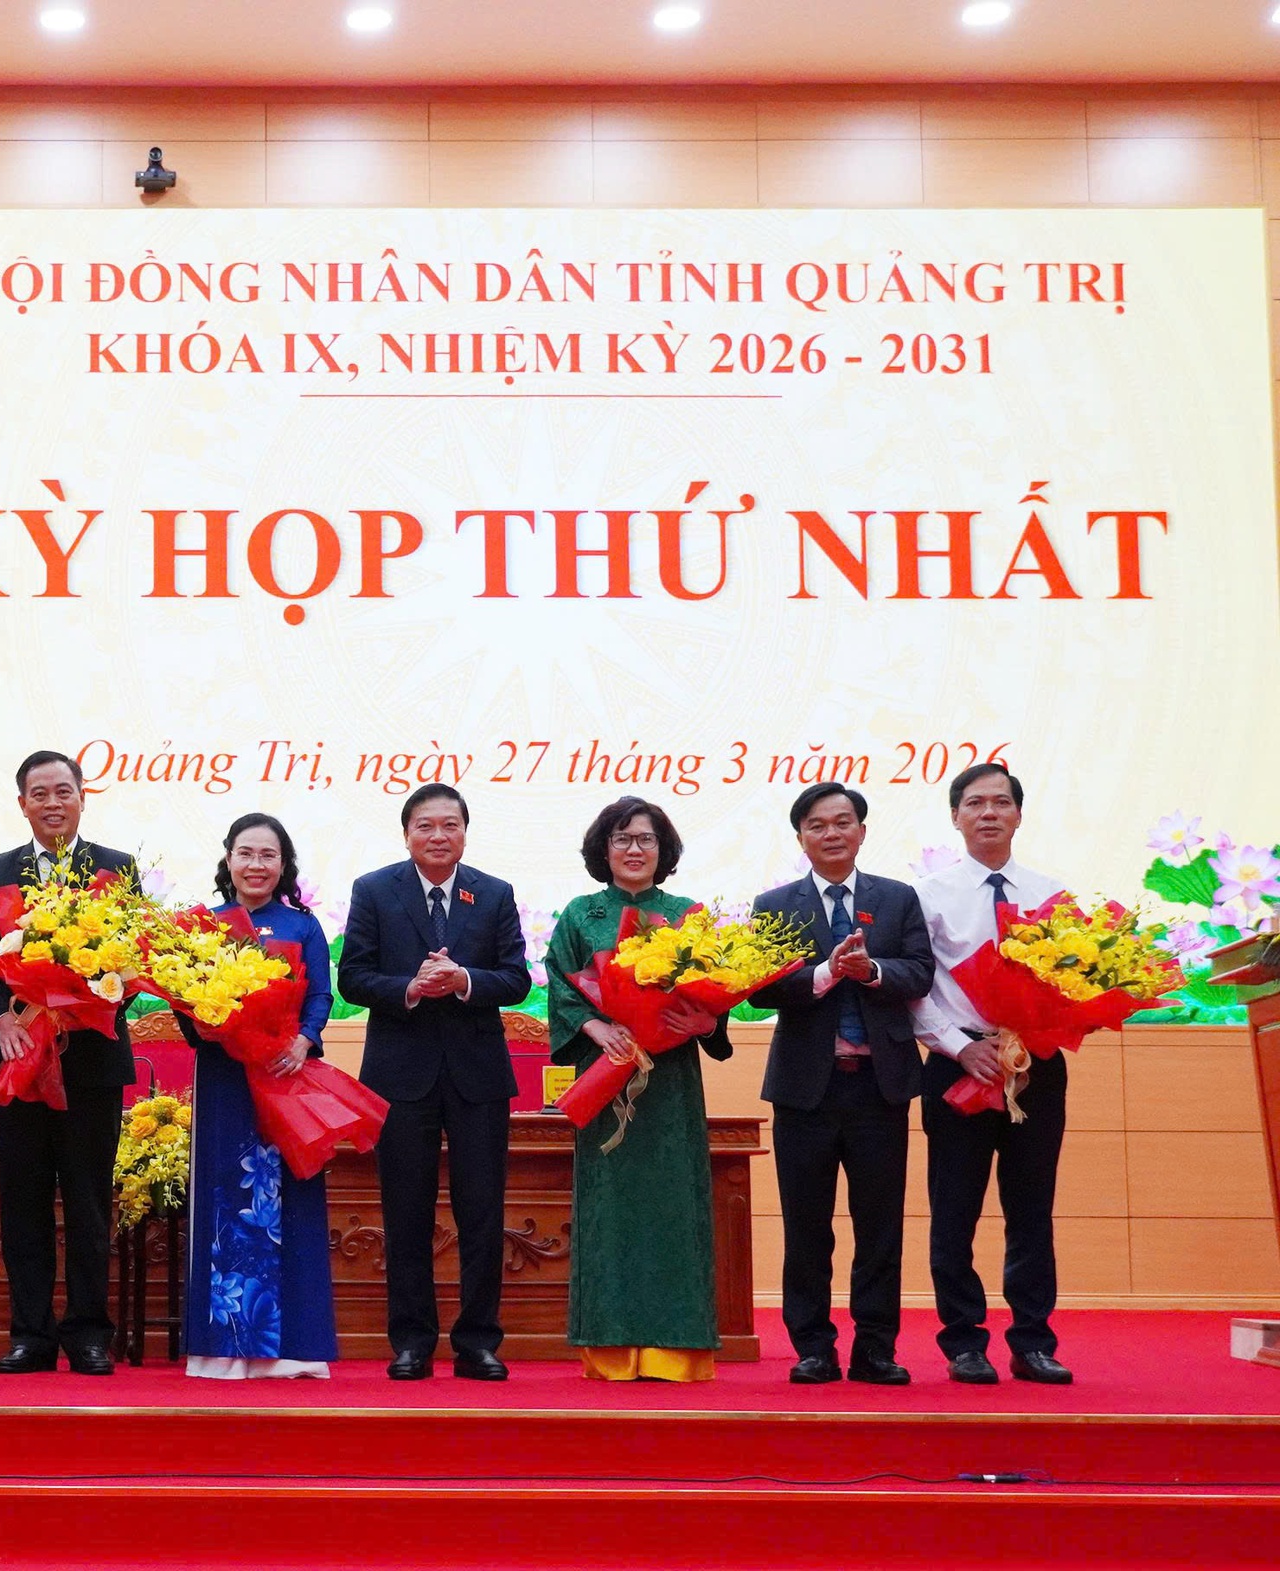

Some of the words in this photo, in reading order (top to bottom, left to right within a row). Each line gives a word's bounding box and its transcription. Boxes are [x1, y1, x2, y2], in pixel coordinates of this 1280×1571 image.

[85, 250, 261, 303] ĐỒNG
[281, 248, 451, 303] NHÂN
[474, 248, 597, 303] DÂN
[616, 250, 765, 303] TỈNH
[785, 250, 1006, 313] QUẢNG
[1024, 262, 1127, 315] TRỊ
[87, 321, 264, 374] KHÓA
[283, 333, 360, 383] IX,
[378, 326, 582, 386] NHIỆM
[606, 321, 689, 374] KỲ
[708, 333, 827, 375] 2026
[844, 356, 863, 364] -
[881, 333, 993, 375] 2031
[142, 508, 424, 626] HỌP
[455, 481, 756, 601] THỨ
[786, 481, 1169, 600] NHẤT
[75, 739, 238, 794] Quảng
[258, 740, 333, 793] Trị,
[355, 740, 473, 795] ngày
[490, 740, 551, 783] 27
[567, 740, 706, 796] tháng
[722, 741, 748, 784] 3
[768, 742, 870, 783] năm
